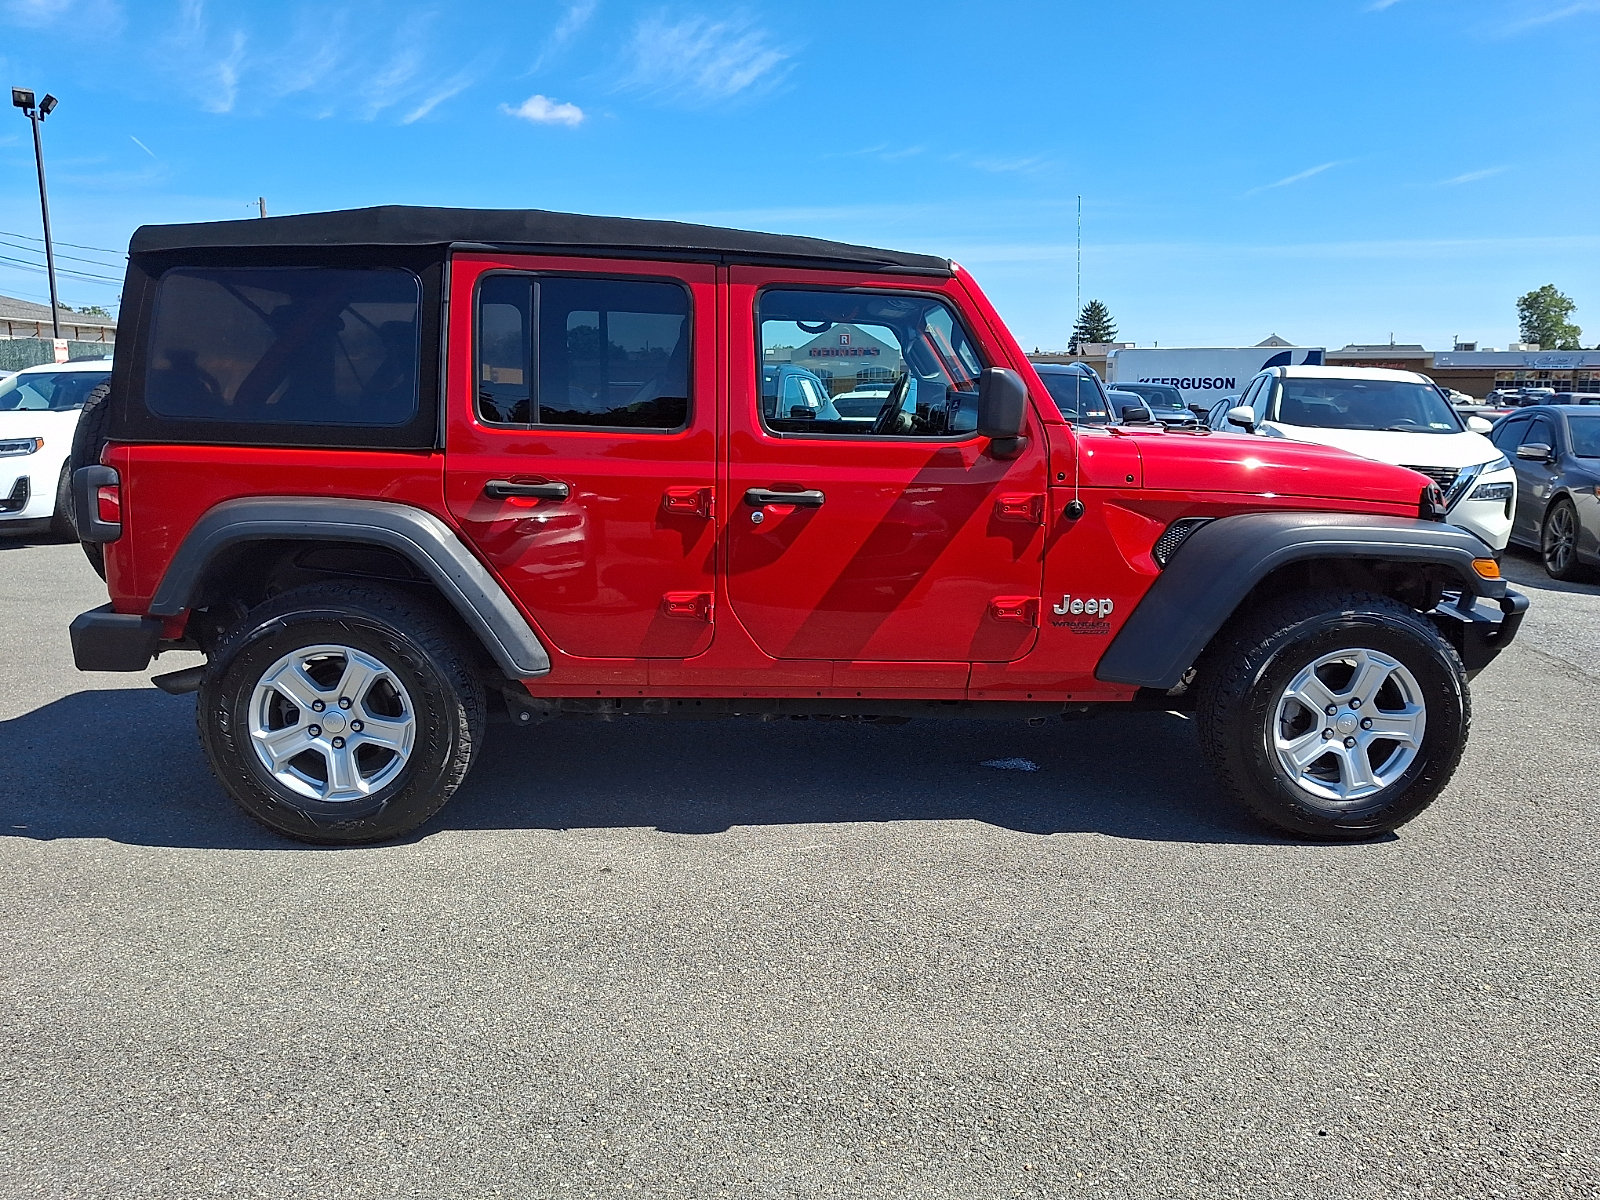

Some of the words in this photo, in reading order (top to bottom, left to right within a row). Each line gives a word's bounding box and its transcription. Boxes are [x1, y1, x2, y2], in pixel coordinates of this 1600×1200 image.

[841, 336, 848, 344] R
[1151, 377, 1236, 390] FERGUSON
[1053, 594, 1114, 619] Jeep
